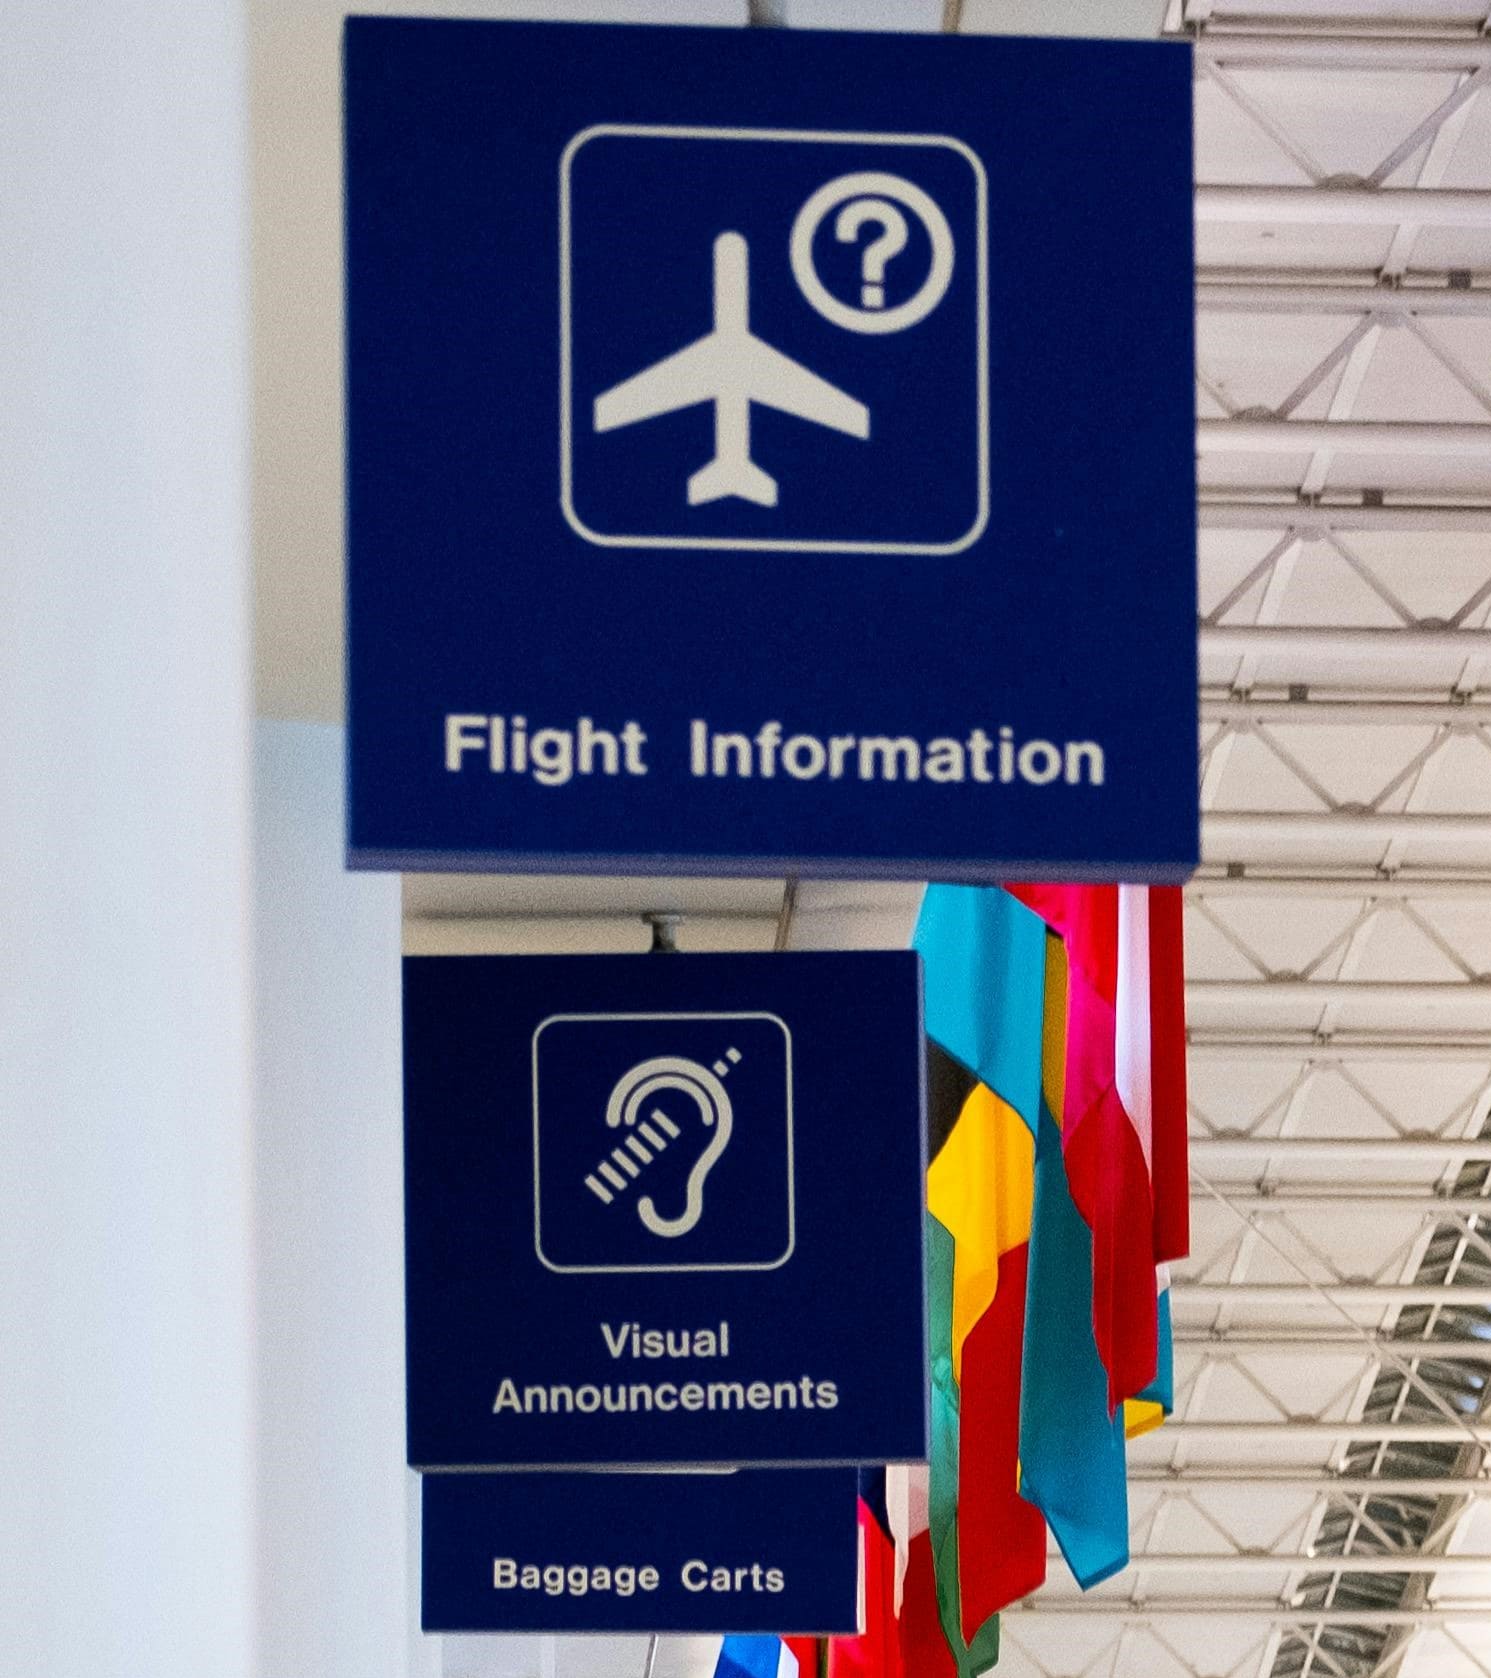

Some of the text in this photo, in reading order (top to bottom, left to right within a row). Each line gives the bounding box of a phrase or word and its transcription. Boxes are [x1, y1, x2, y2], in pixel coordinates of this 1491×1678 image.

[445, 715, 1105, 786] Flight Information
[601, 1321, 729, 1359] Visual
[493, 1375, 839, 1414] Announcements
[493, 1559, 784, 1596] Baggage Carts
